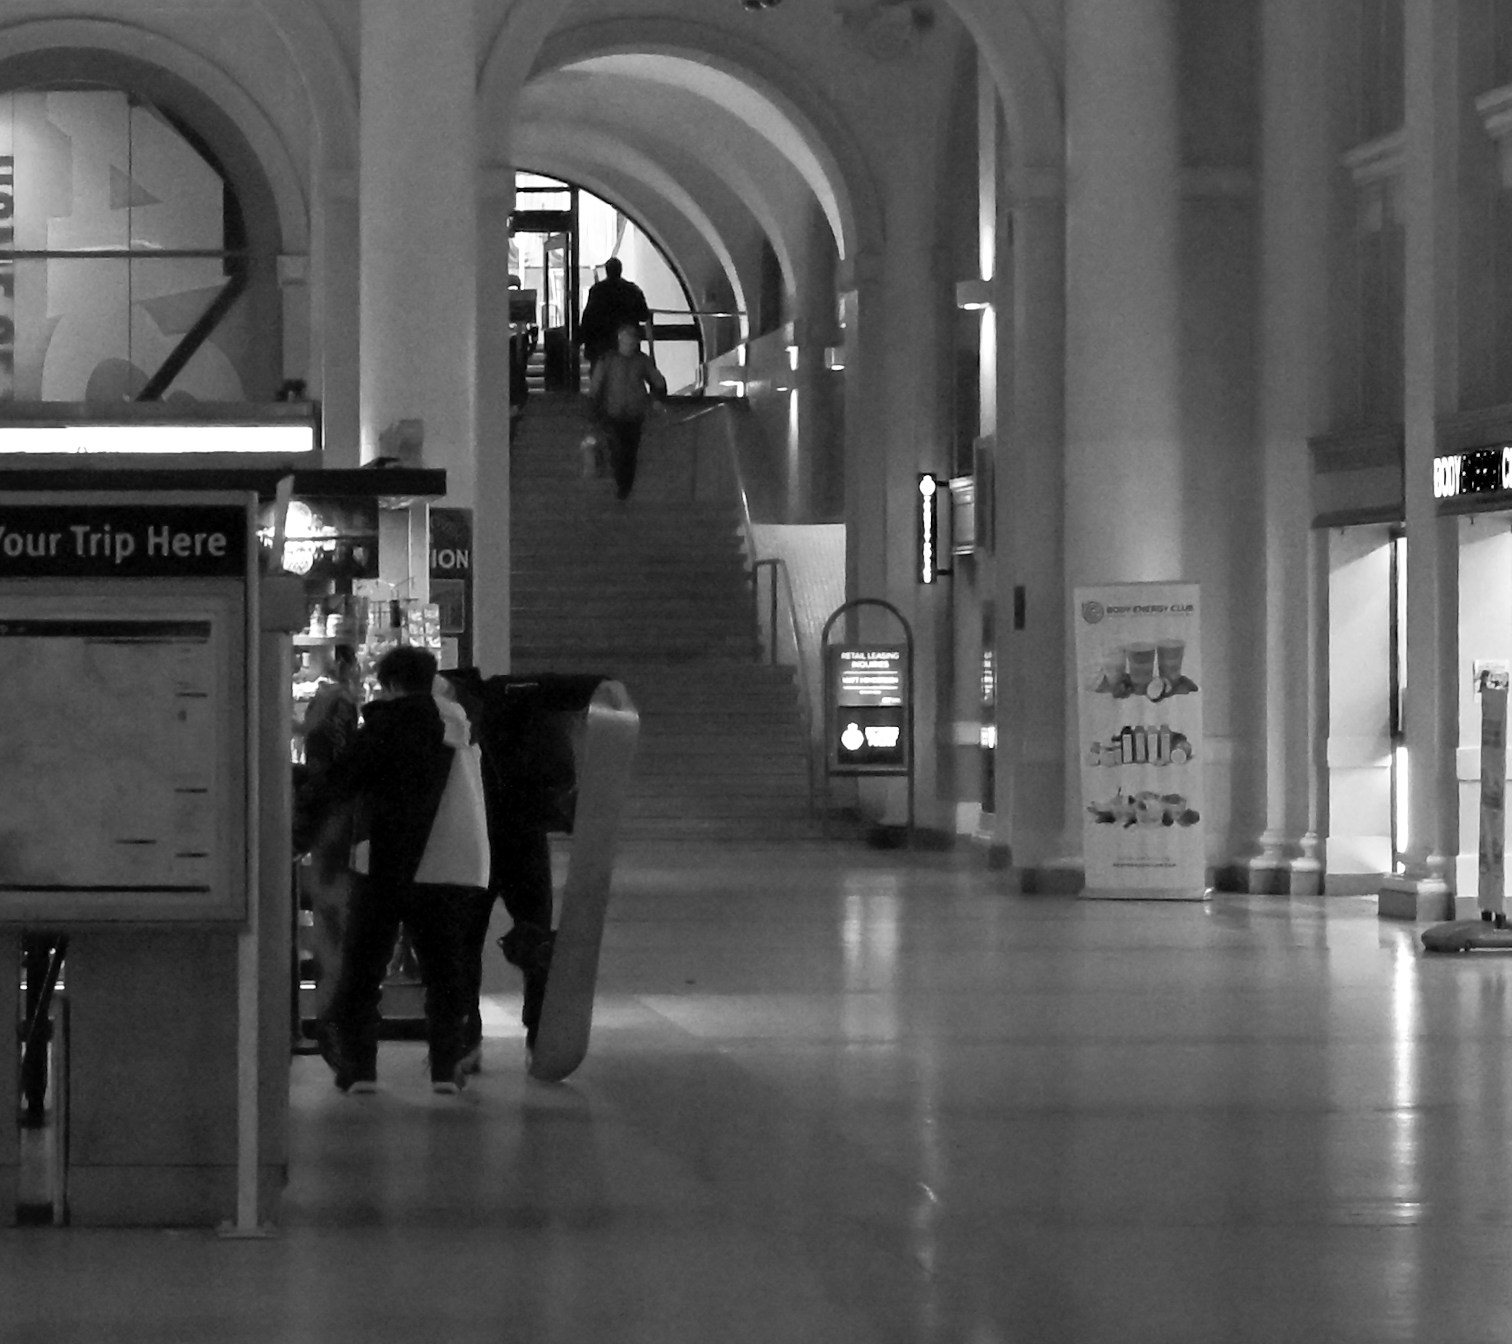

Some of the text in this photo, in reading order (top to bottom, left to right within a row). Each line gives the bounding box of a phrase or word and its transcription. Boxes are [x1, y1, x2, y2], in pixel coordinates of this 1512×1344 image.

[1433, 455, 1462, 499] BODY
[70, 524, 134, 564] Trip
[147, 526, 226, 557] Here
[431, 549, 469, 569] ION
